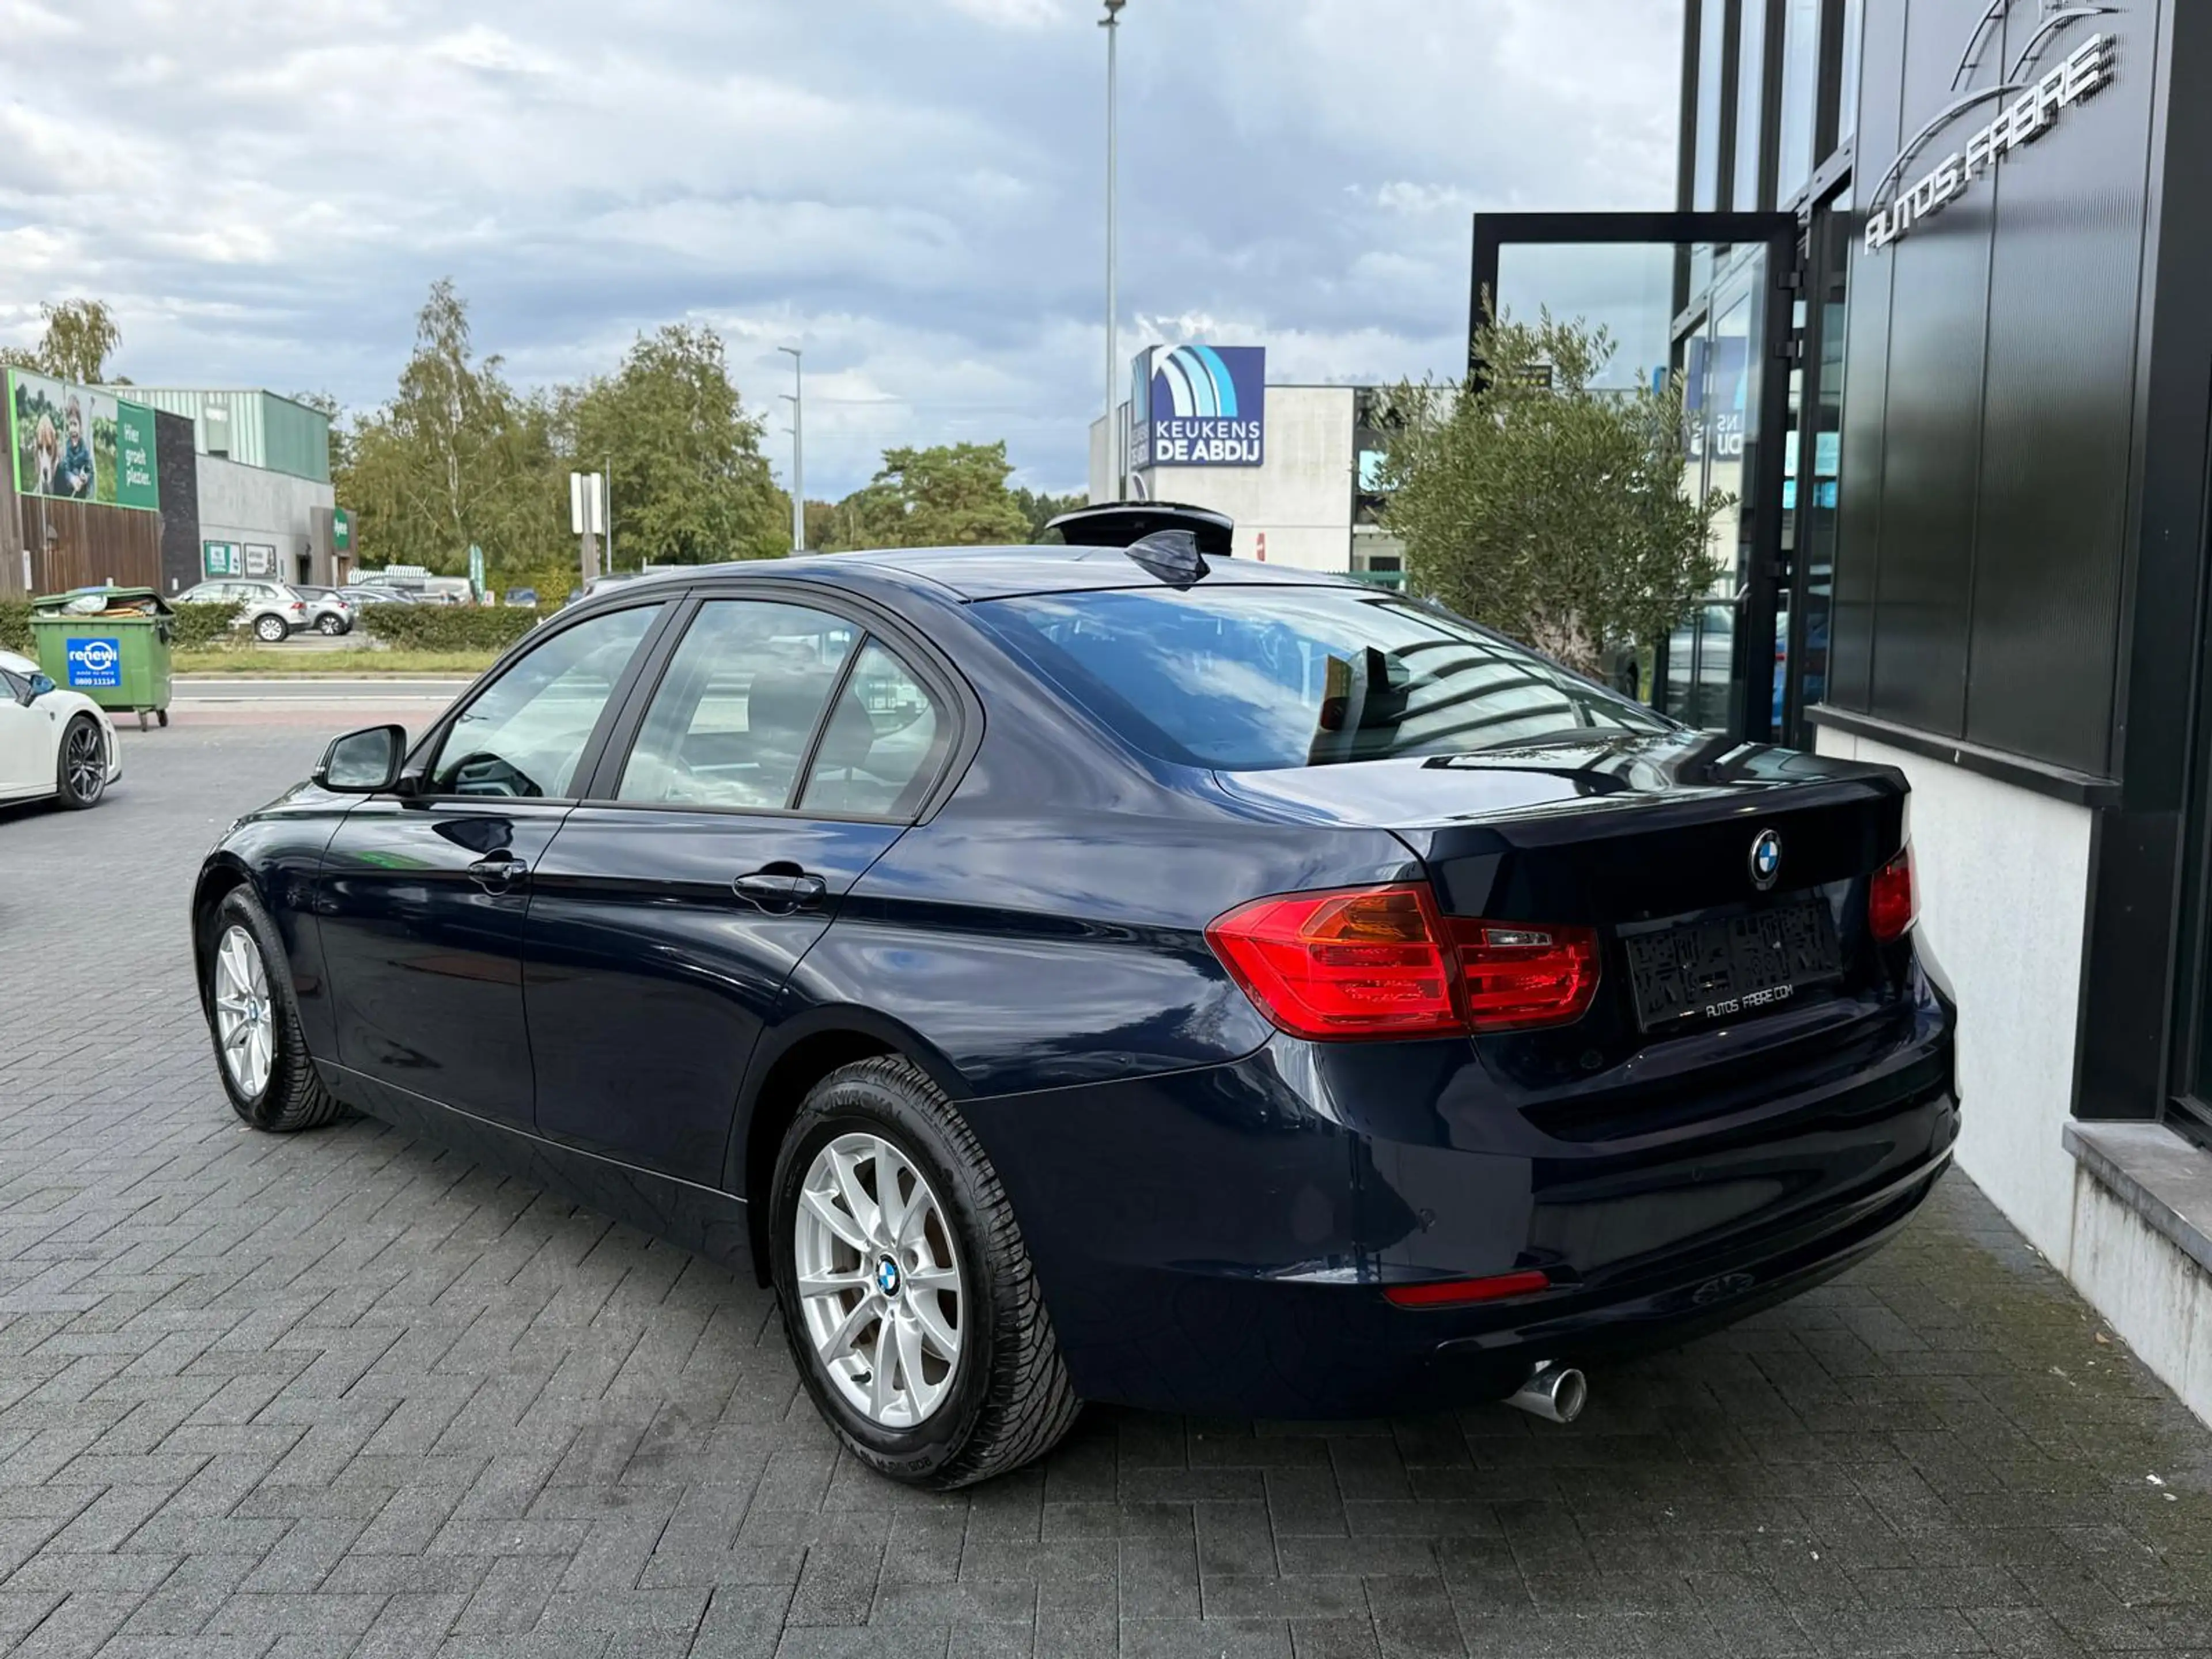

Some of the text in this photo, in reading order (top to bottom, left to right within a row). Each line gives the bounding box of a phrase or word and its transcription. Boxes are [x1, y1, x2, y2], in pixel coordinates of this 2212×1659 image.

[1865, 33, 2100, 255] AUTOS FABRE
[1156, 421, 1260, 438] KEUKENS
[1156, 439, 1188, 461] DE
[1191, 439, 1260, 461] ABDIJ
[69, 649, 117, 661] renewi
[1706, 999, 1738, 1018] AUTOS
